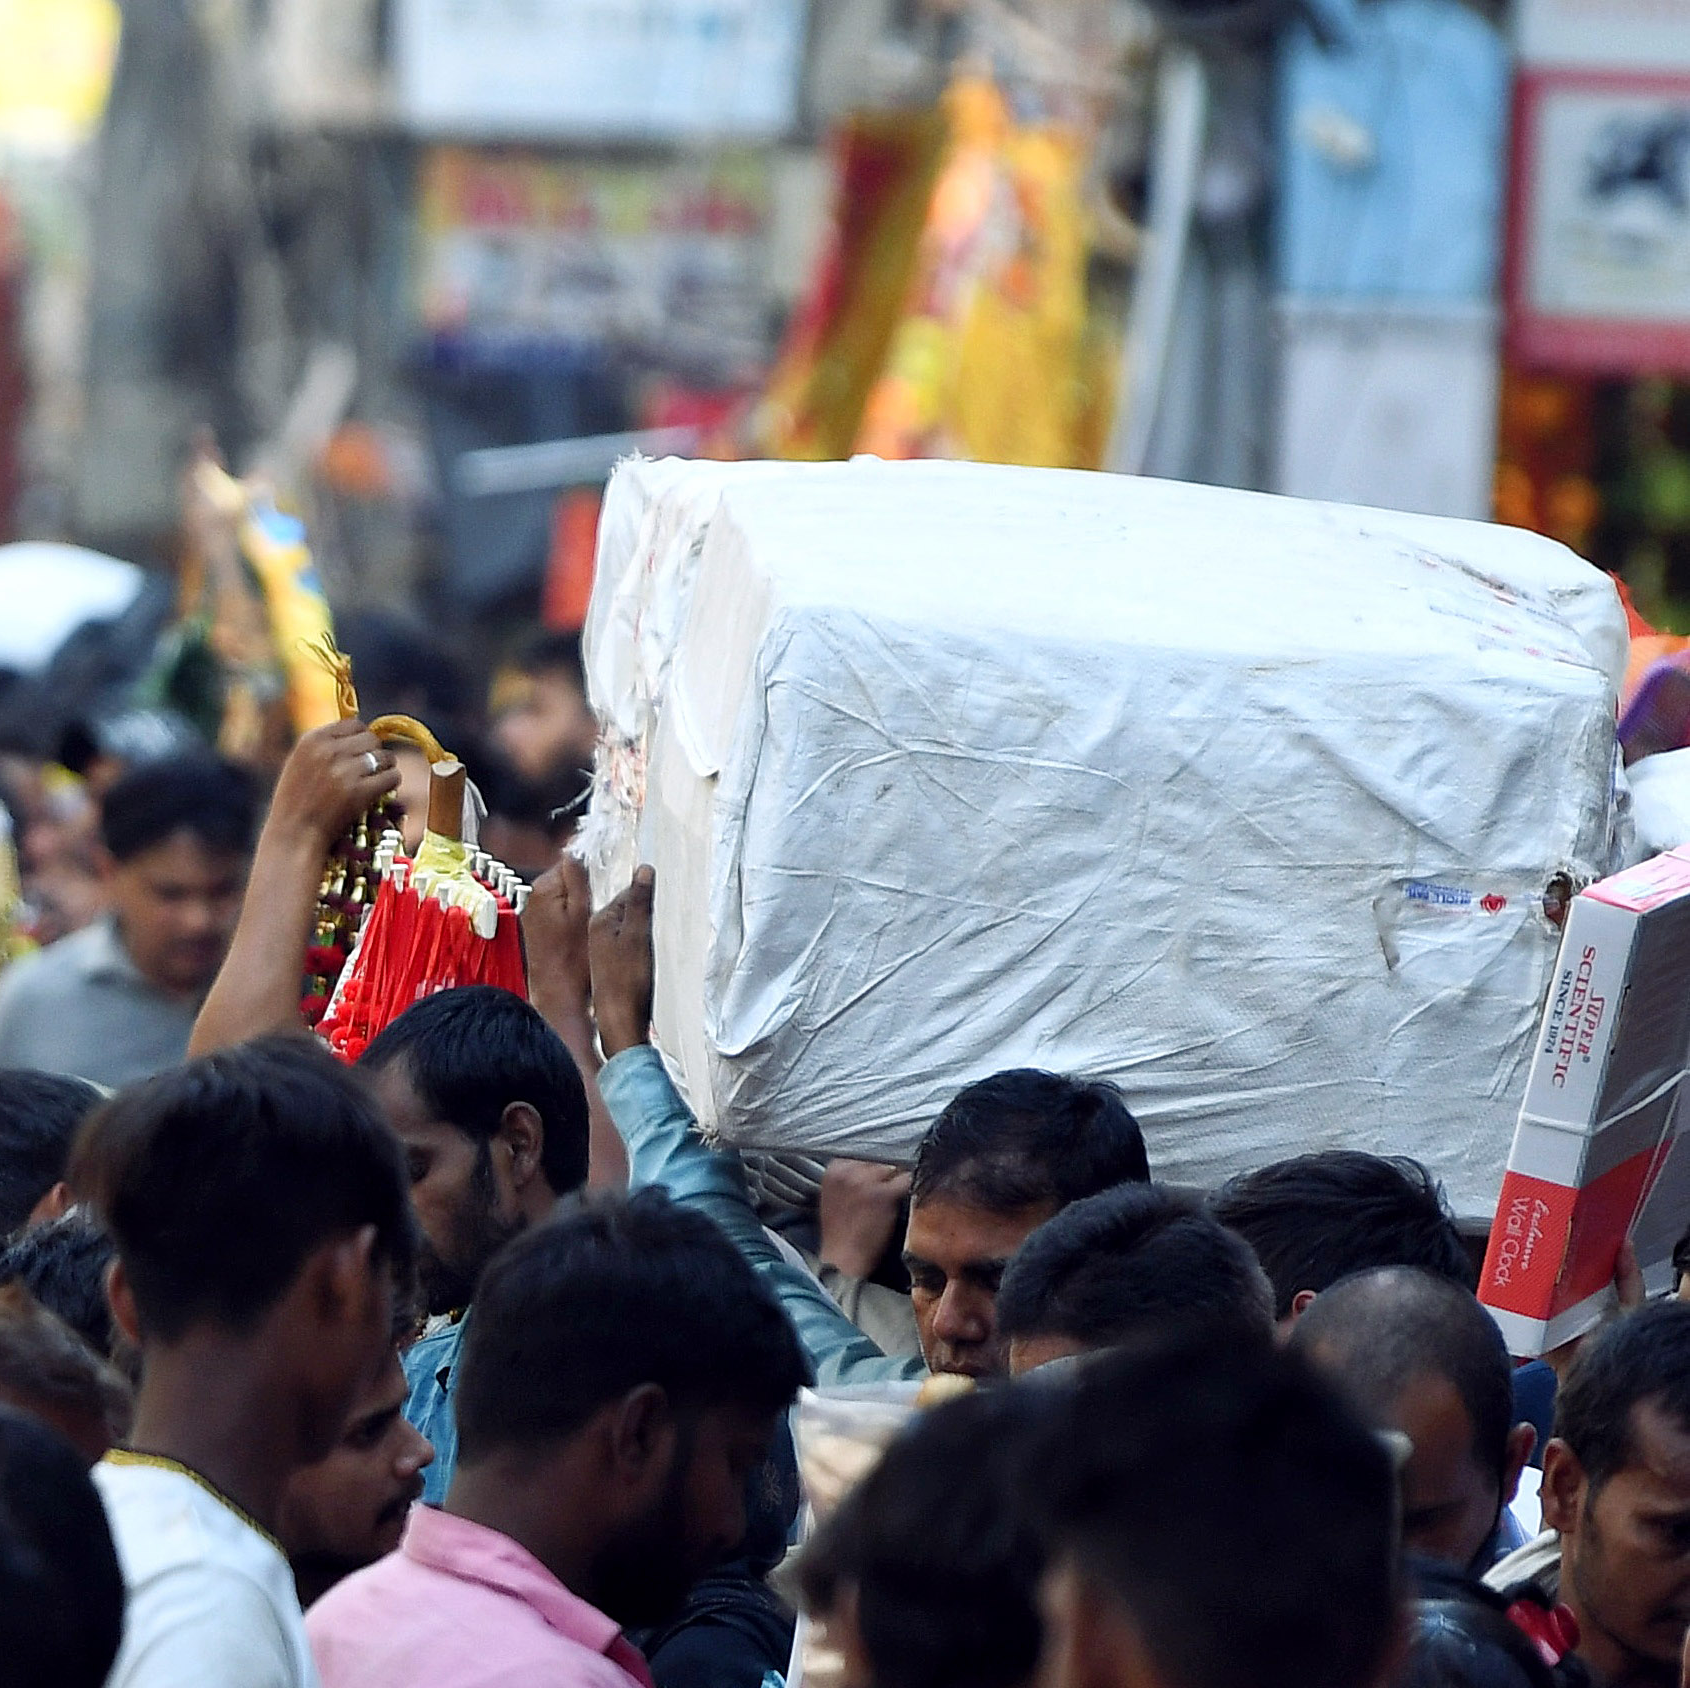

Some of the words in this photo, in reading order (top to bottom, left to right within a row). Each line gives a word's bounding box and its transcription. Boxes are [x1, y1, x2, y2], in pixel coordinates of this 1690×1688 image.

[1552, 968, 1572, 1022] SINCE
[1552, 945, 1596, 1089] SCIENTIFIC
[1544, 1024, 1560, 1054] 1974
[1577, 988, 1605, 1056] SUPER
[1506, 1197, 1531, 1237] Wall
[1493, 1238, 1520, 1287] Clock
